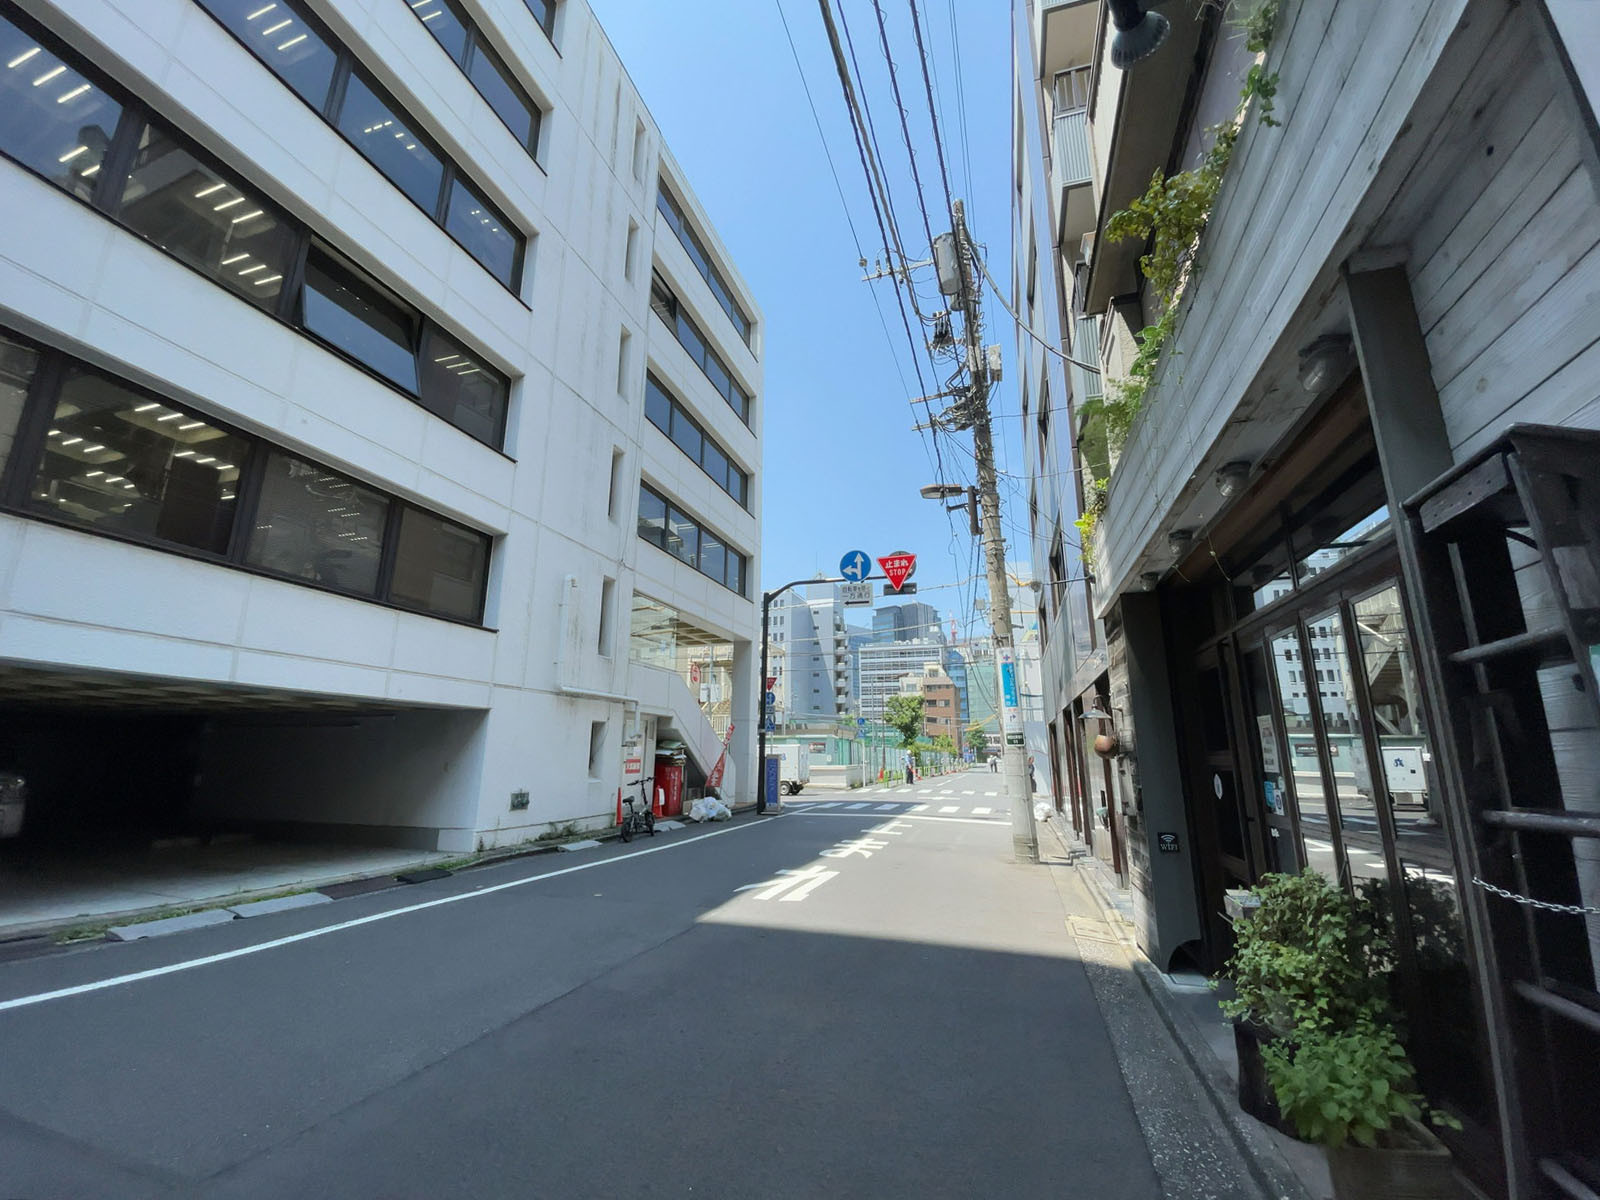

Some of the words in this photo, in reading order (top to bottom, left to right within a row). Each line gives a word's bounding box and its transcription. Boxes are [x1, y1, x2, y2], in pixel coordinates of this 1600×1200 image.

[885, 559, 909, 569] 止まれ
[889, 568, 906, 576] STOP
